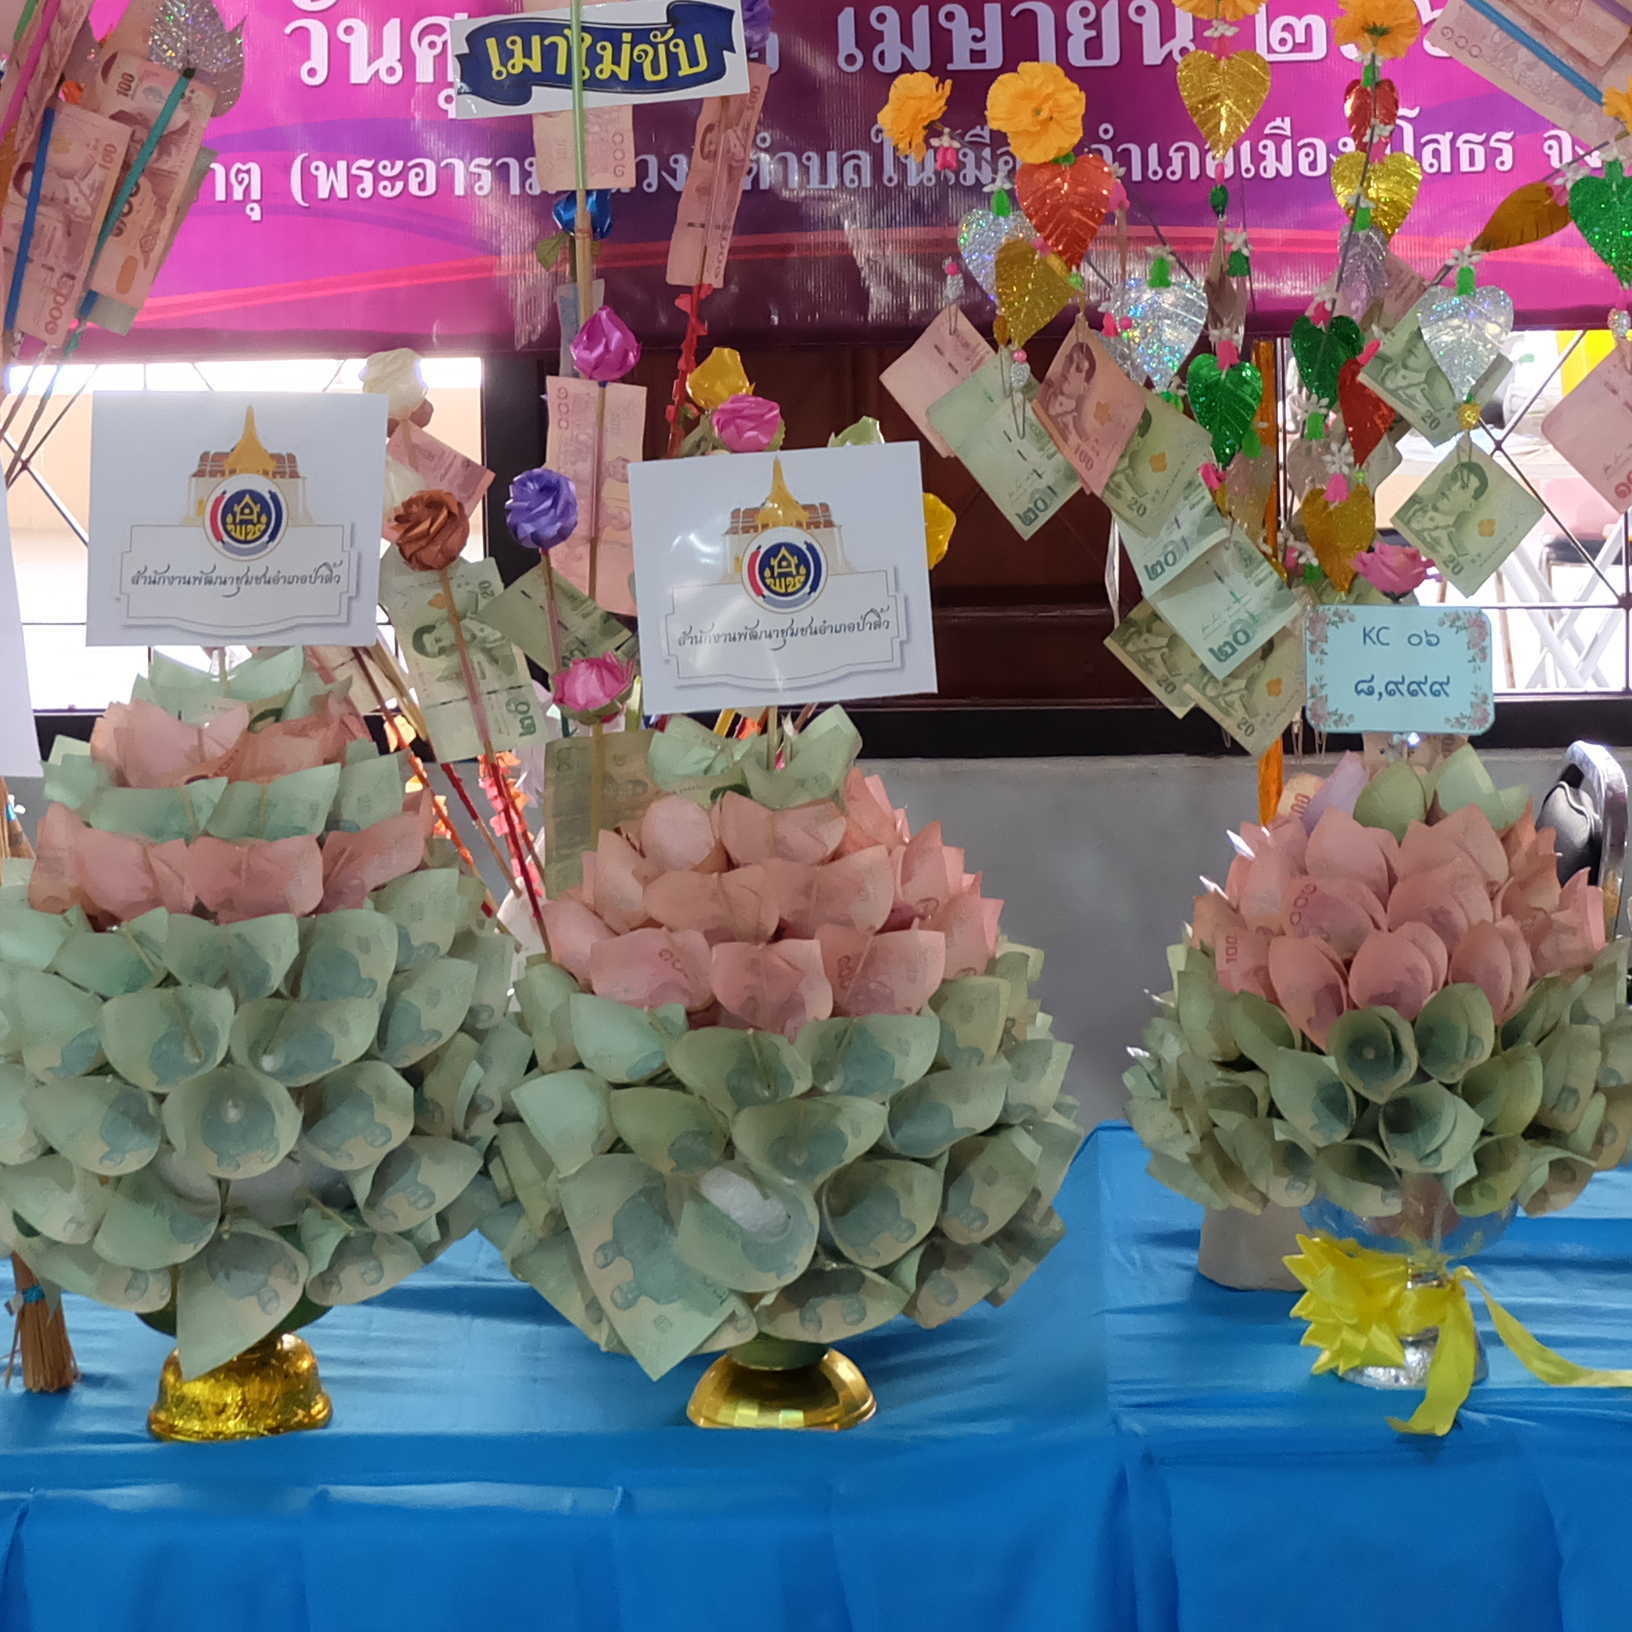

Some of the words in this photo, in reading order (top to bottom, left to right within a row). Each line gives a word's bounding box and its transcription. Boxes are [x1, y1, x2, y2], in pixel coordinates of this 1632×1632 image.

[485, 28, 709, 82] เมาไม่ขับ
[116, 71, 136, 98] 100
[1419, 408, 1442, 431] 20
[1126, 496, 1148, 519] 20
[131, 559, 343, 599] สำนักงานพัฒนาชุมชนอำเภอป่าติ้ว
[1441, 554, 1464, 578] 20
[677, 605, 891, 652] สำนักงานพัฒนาชุมชนอำเภอป่าติ้ว
[1362, 626, 1391, 646] KC
[1353, 673, 1451, 702] ๘,๙๙๙
